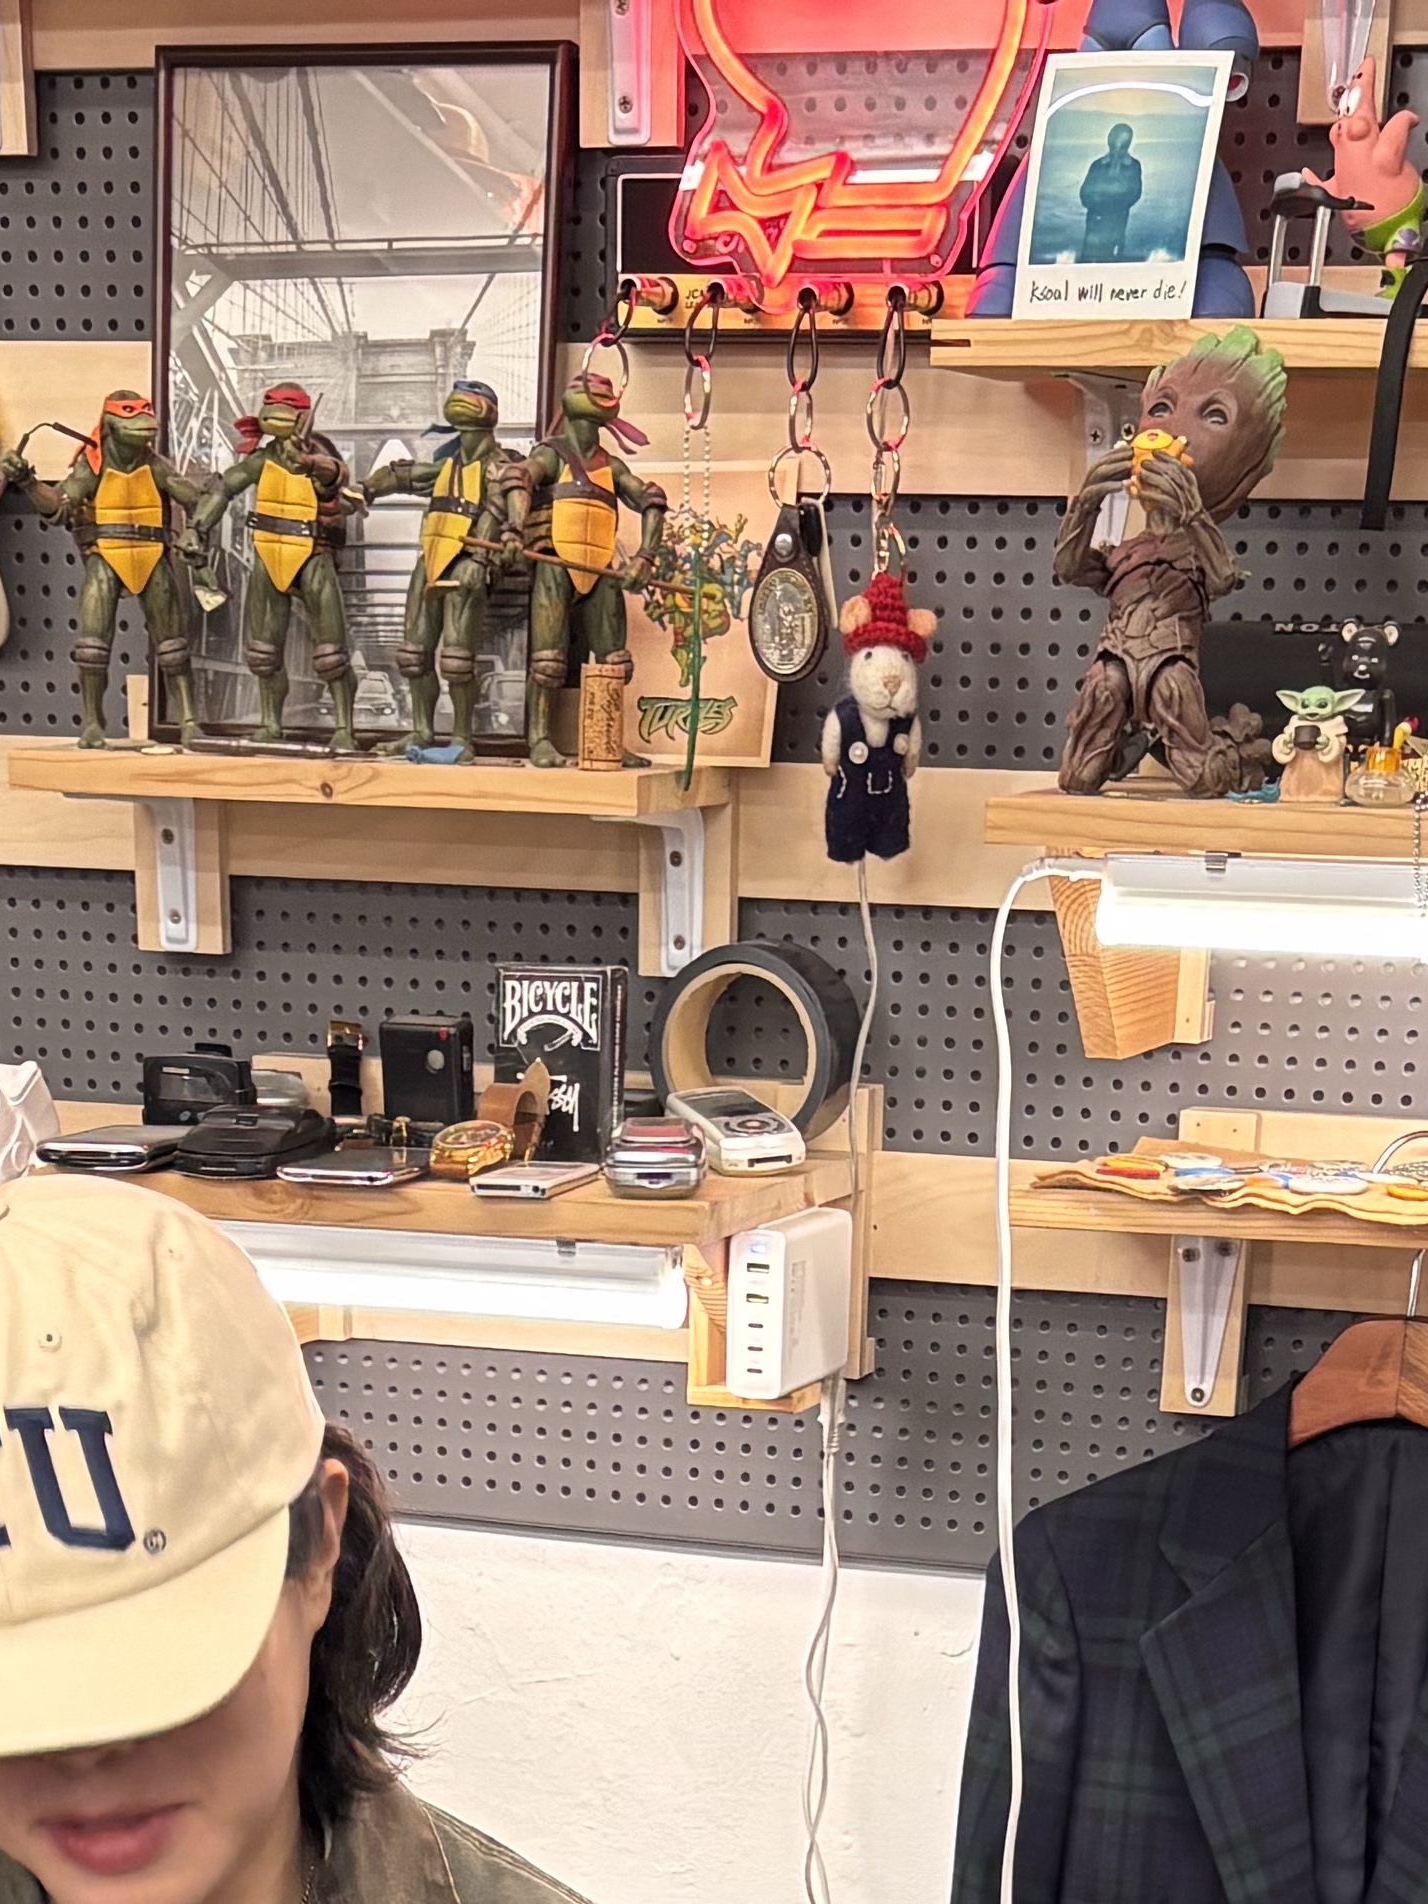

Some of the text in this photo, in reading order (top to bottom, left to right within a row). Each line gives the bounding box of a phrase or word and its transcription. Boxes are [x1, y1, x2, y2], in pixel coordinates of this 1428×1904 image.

[1077, 283, 1103, 302] will
[1110, 287, 1147, 301] never
[503, 979, 598, 1045] BICYCLE
